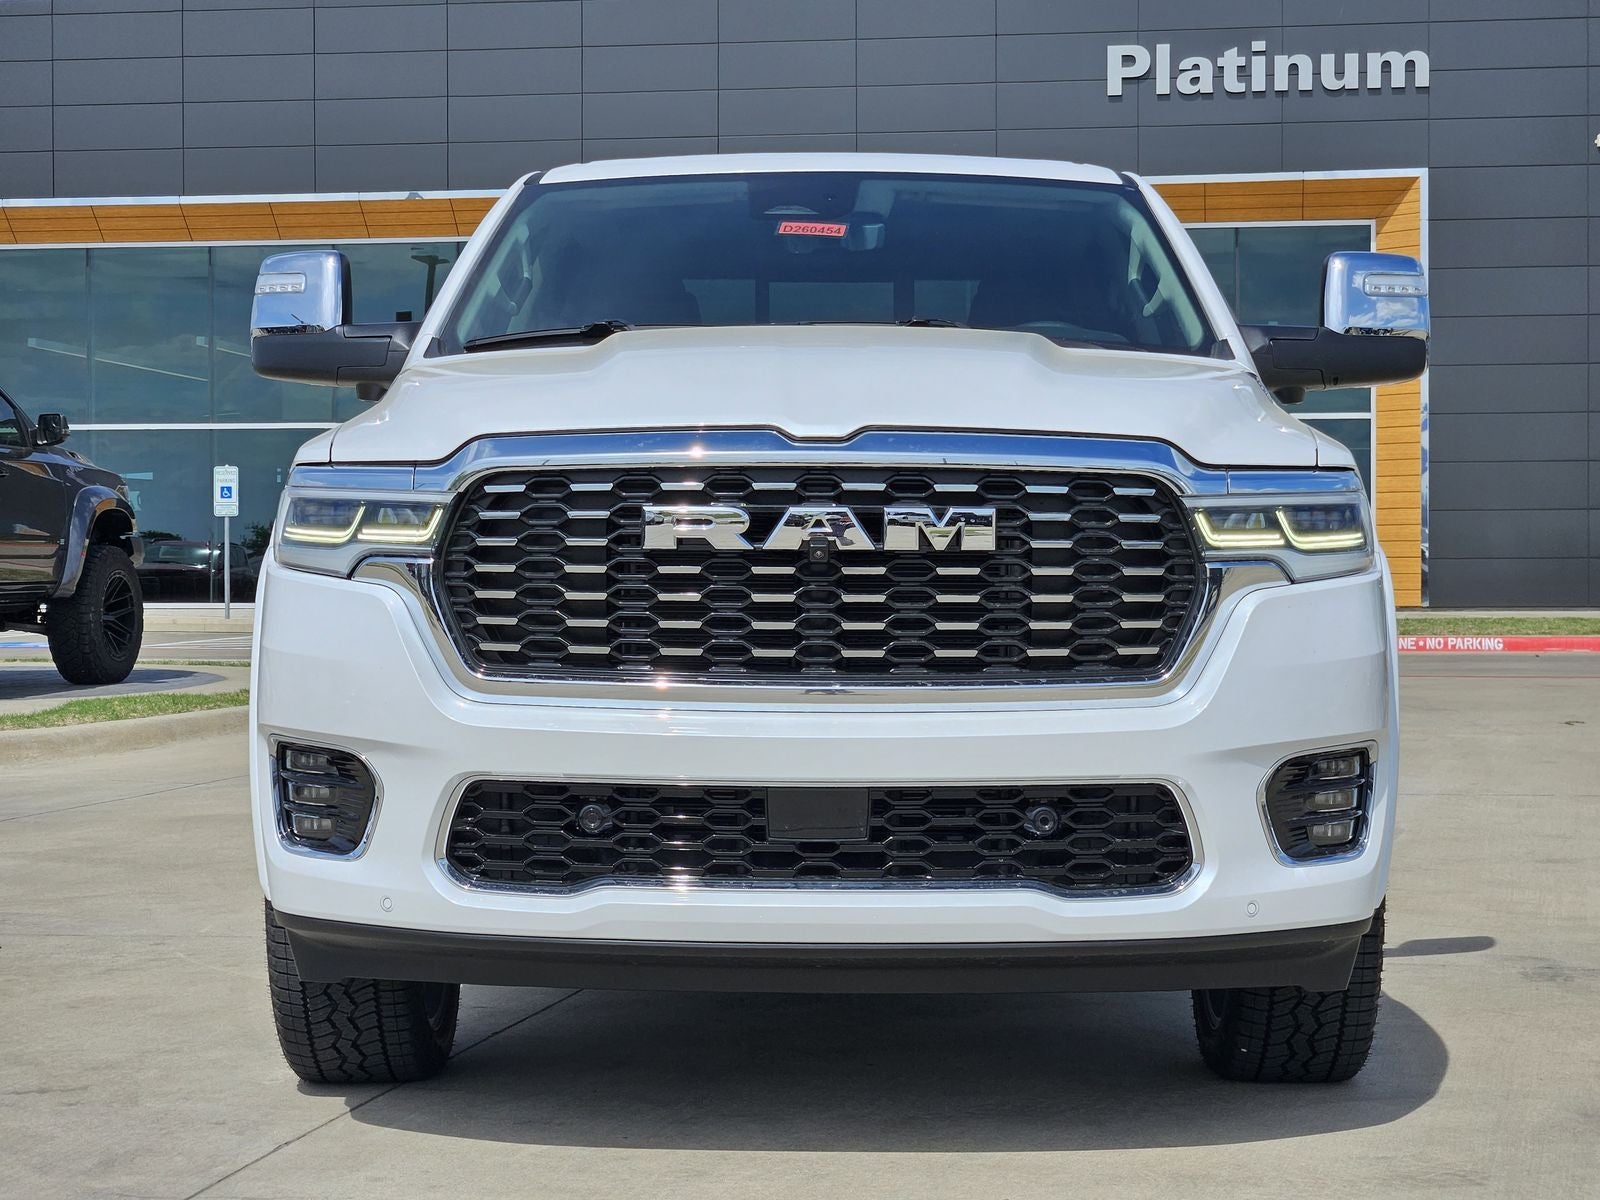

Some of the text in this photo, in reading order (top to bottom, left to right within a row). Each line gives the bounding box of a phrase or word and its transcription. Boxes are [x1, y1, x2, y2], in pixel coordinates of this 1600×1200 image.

[1106, 40, 1430, 96] Platinum
[782, 224, 843, 235] D260454
[641, 505, 996, 551] RAM
[1426, 637, 1444, 650] NO
[1447, 637, 1504, 650] PARKING
